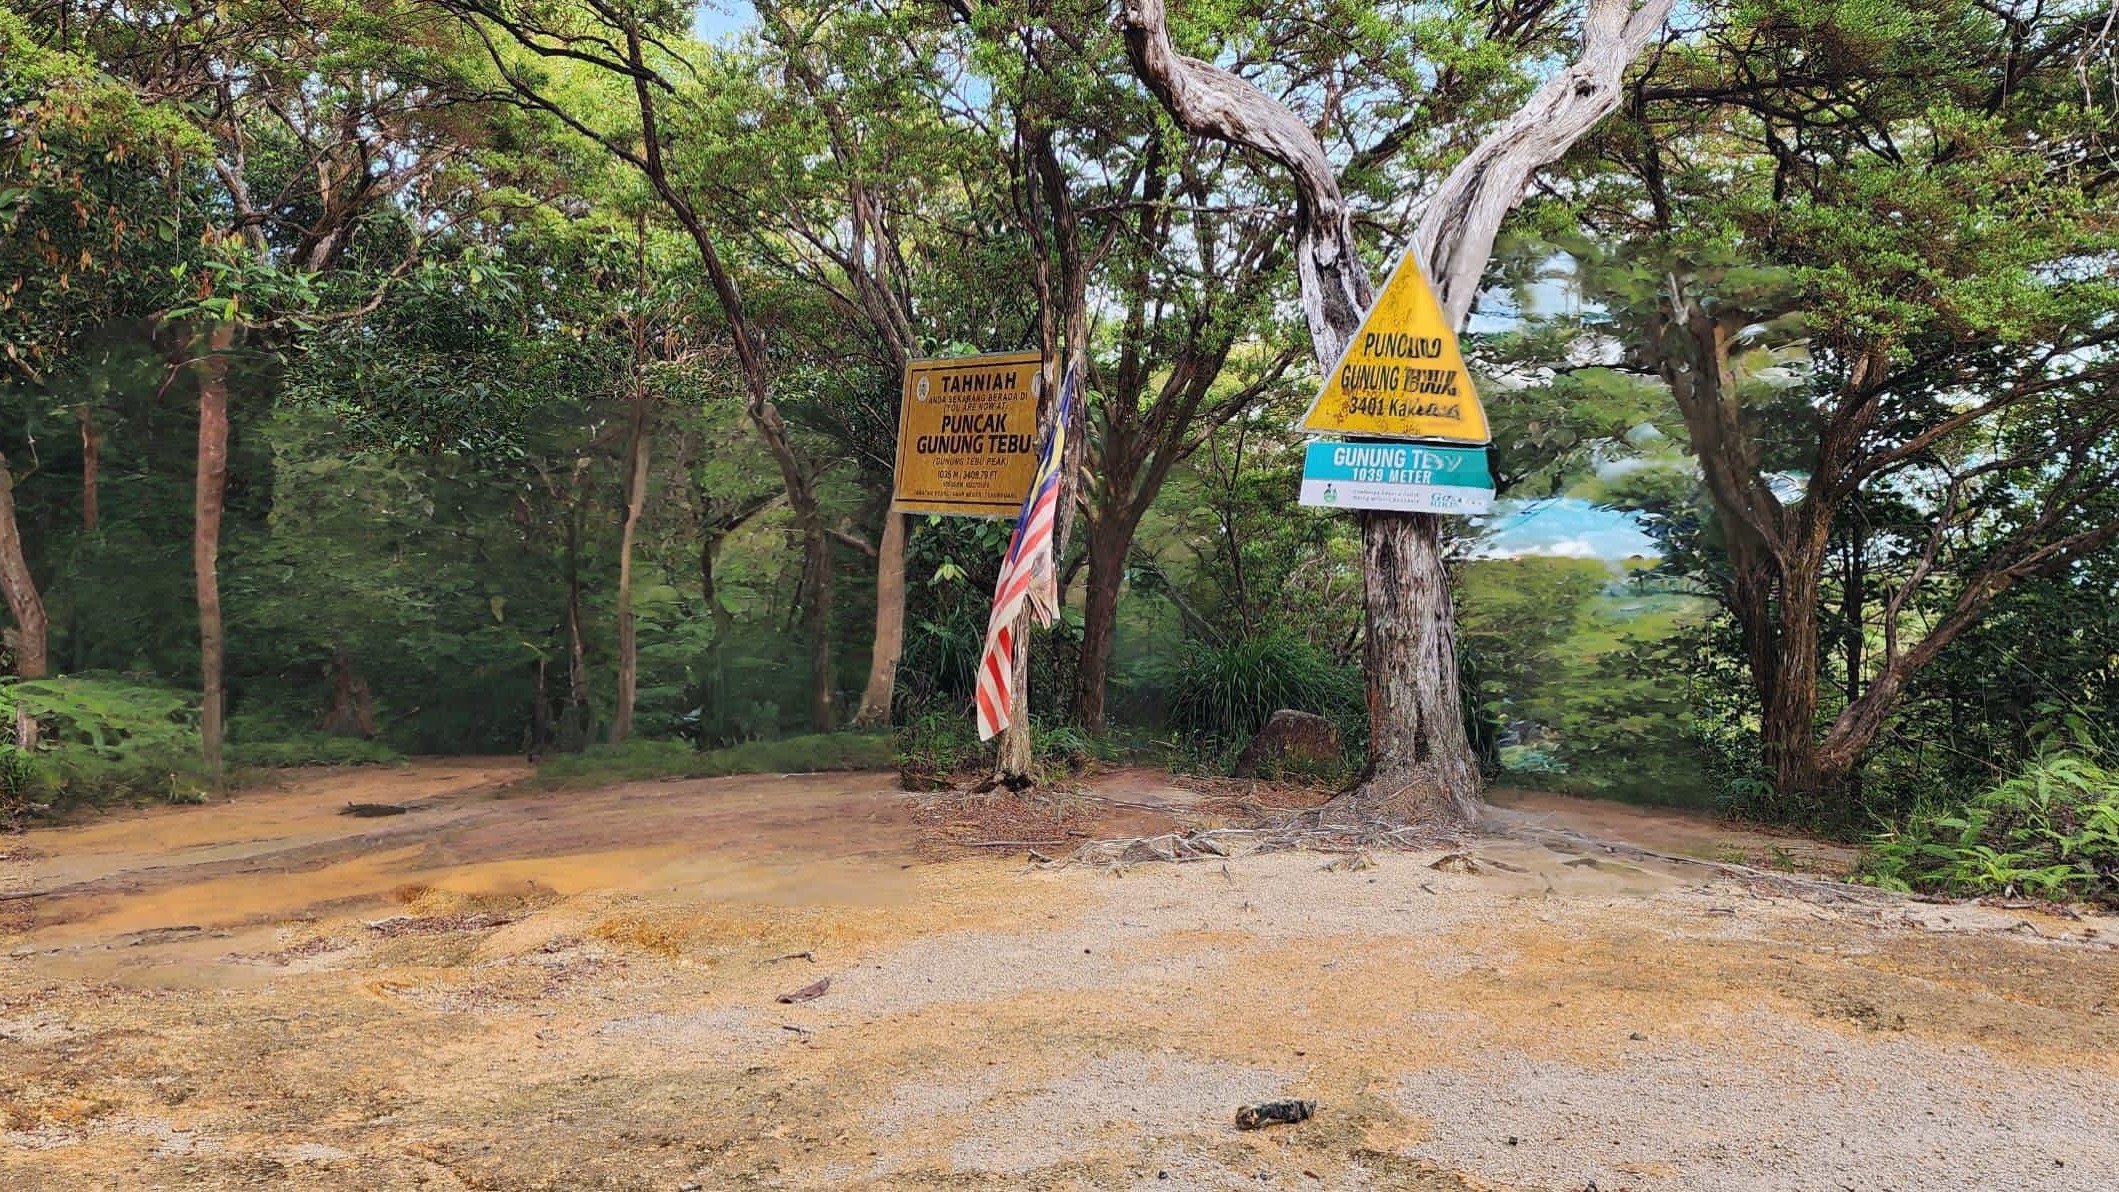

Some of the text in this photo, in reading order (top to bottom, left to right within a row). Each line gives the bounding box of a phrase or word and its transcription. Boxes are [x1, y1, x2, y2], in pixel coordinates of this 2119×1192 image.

[941, 372, 1017, 393] TAHNIAH
[1341, 364, 1399, 392] GUNUNG
[947, 393, 986, 404] SEKARANG
[988, 392, 1018, 402] BERADA
[1019, 391, 1029, 401] DI
[1349, 396, 1384, 415] 3401
[941, 413, 1007, 434] PUNCAK
[916, 434, 1032, 455] GUNUNG TEBU
[966, 456, 985, 466] TEBU
[1333, 447, 1406, 469] GUNUNG
[1352, 467, 1432, 485] 1039 METER
